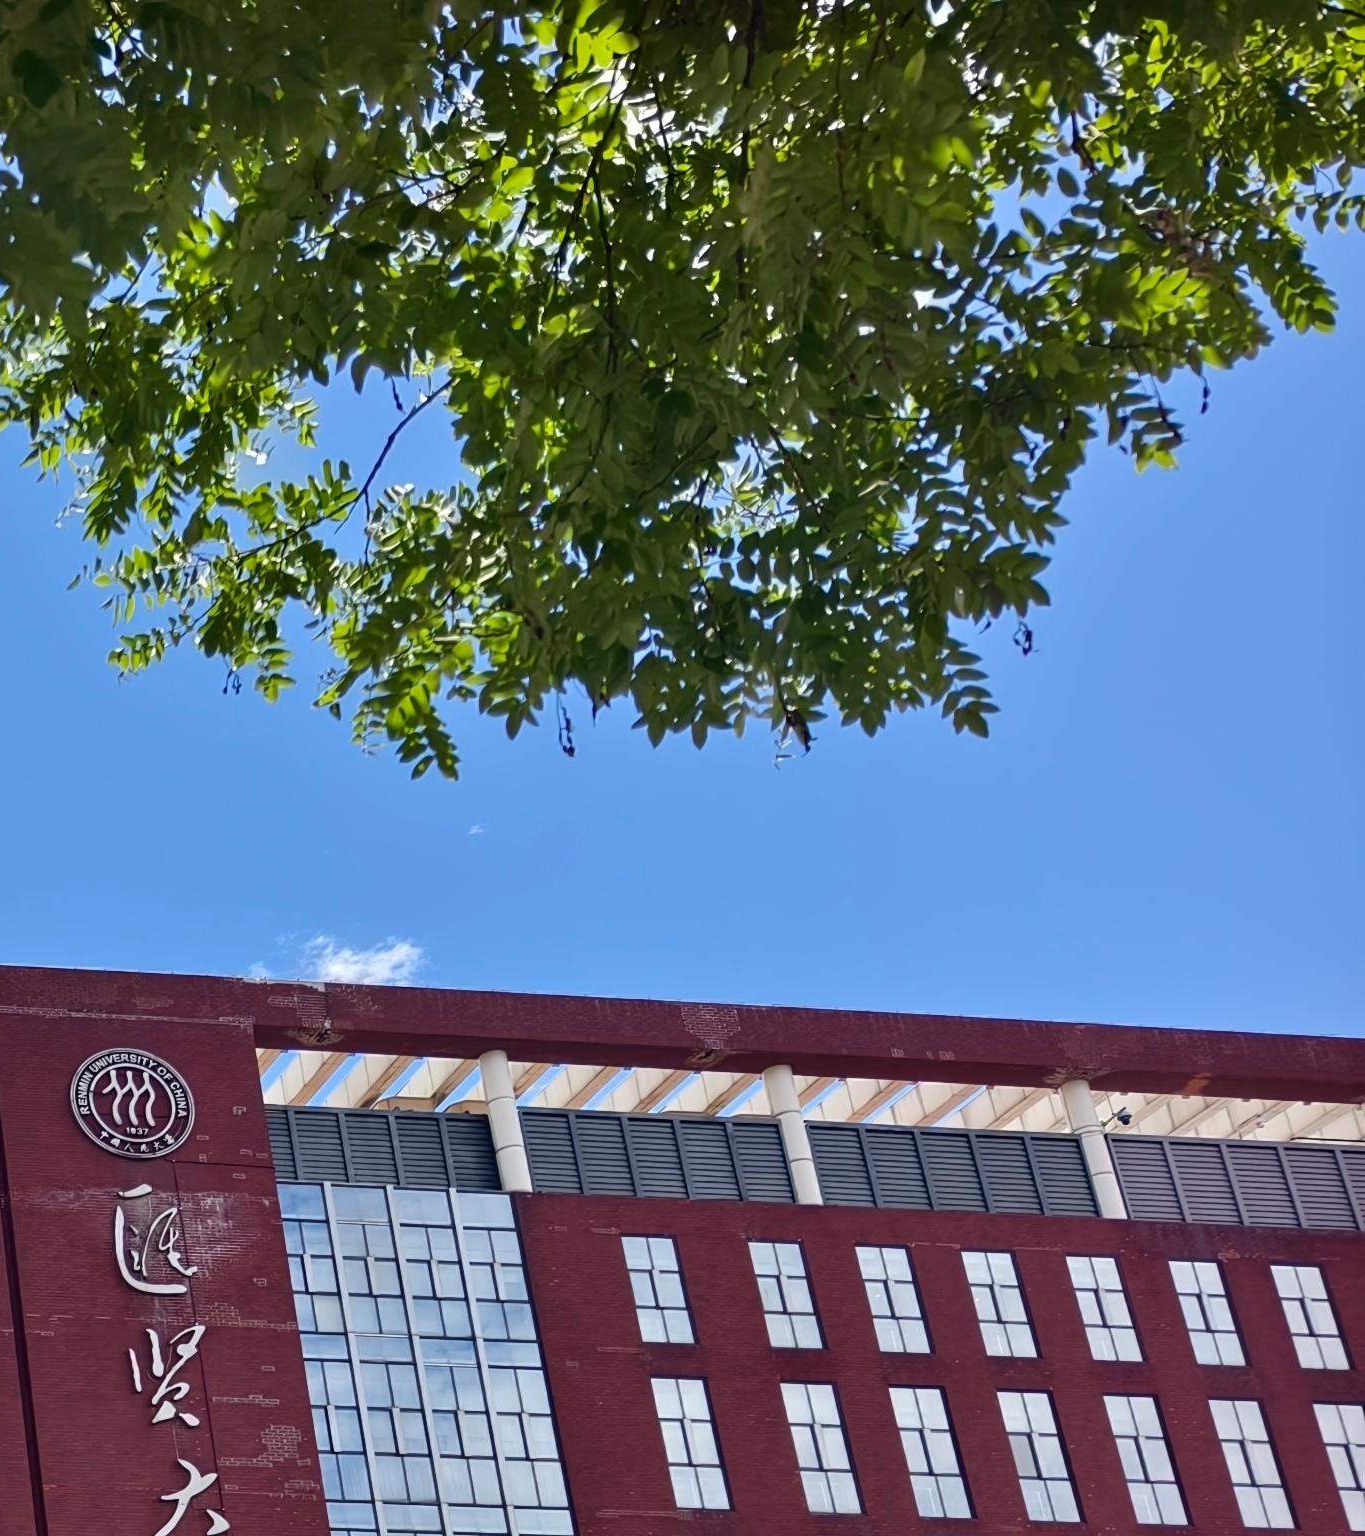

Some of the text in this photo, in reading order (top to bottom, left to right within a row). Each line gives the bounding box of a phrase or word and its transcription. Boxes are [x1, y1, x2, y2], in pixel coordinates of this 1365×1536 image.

[77, 1053, 187, 1118] RENMIN UNIVERSITY OF CHINA
